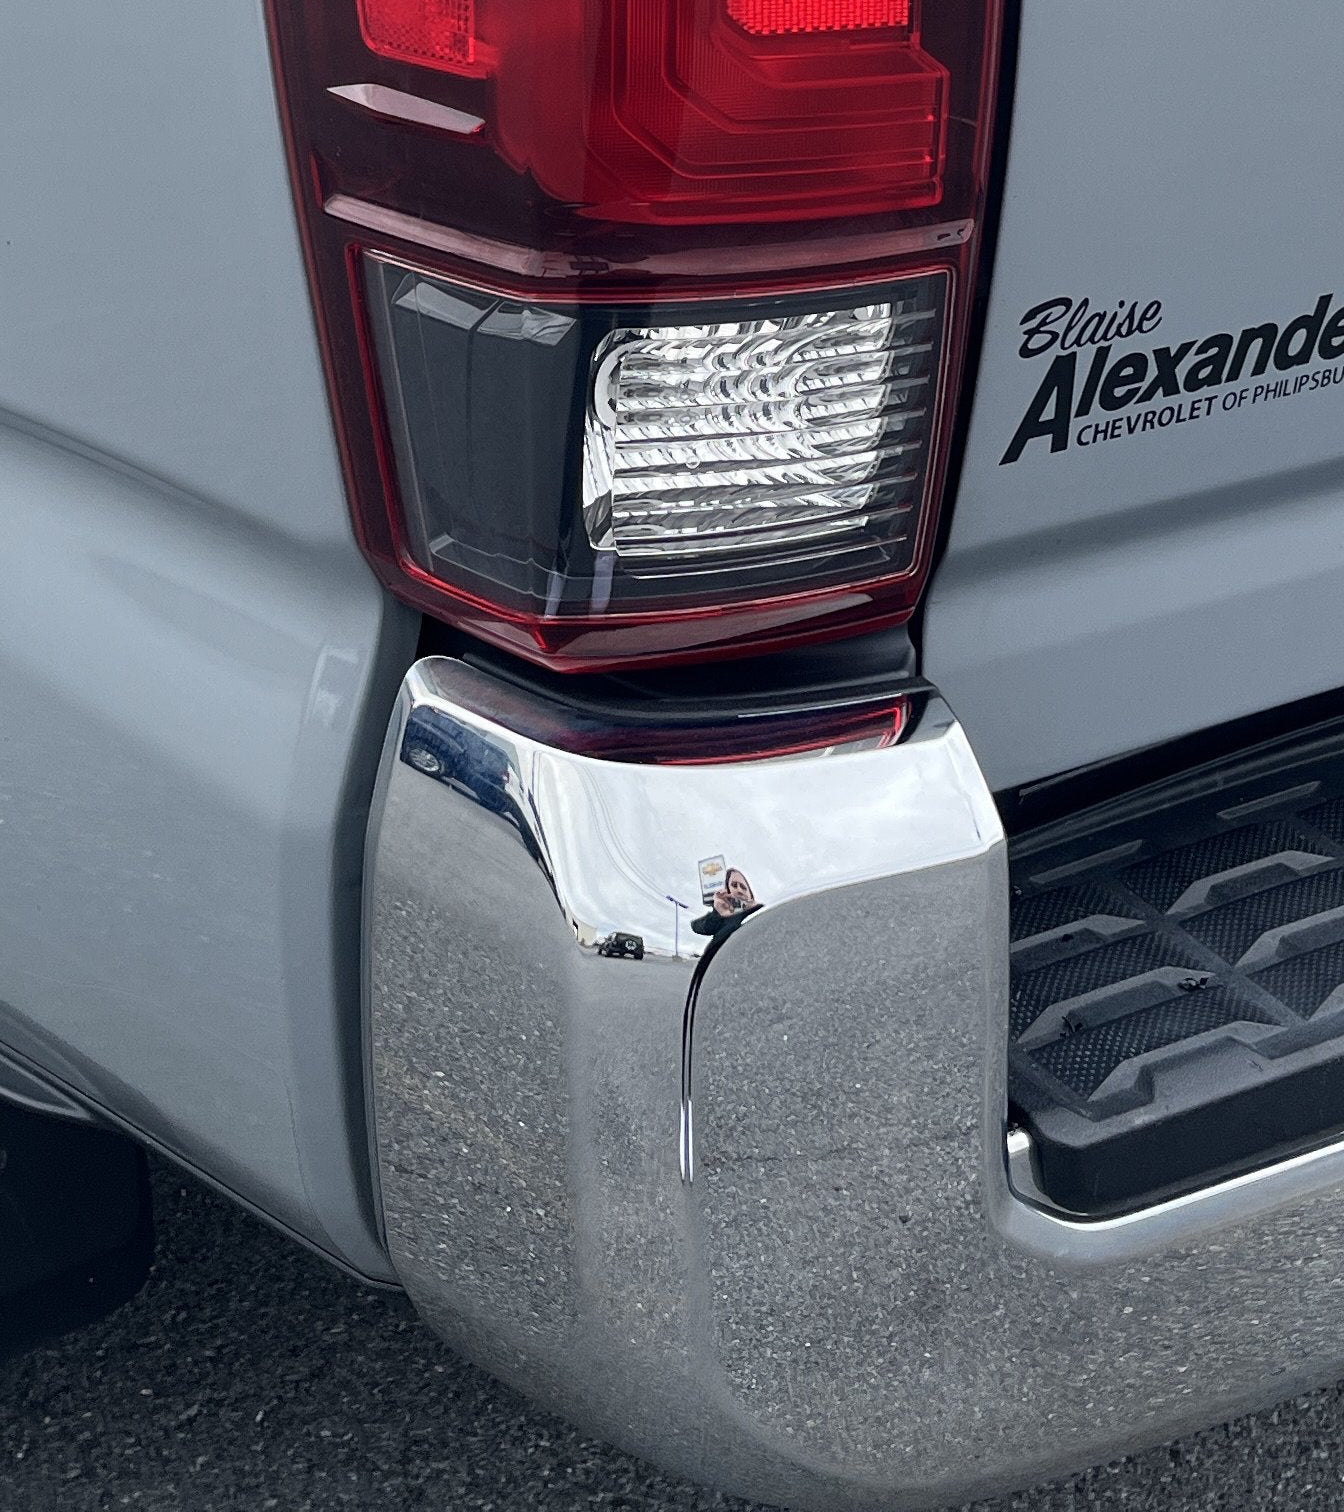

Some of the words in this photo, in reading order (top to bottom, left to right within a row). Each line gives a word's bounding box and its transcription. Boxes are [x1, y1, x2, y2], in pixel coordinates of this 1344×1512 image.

[1017, 296, 1163, 360] Blaise
[1075, 395, 1218, 448] CHEVROLET
[1221, 388, 1250, 412] OF
